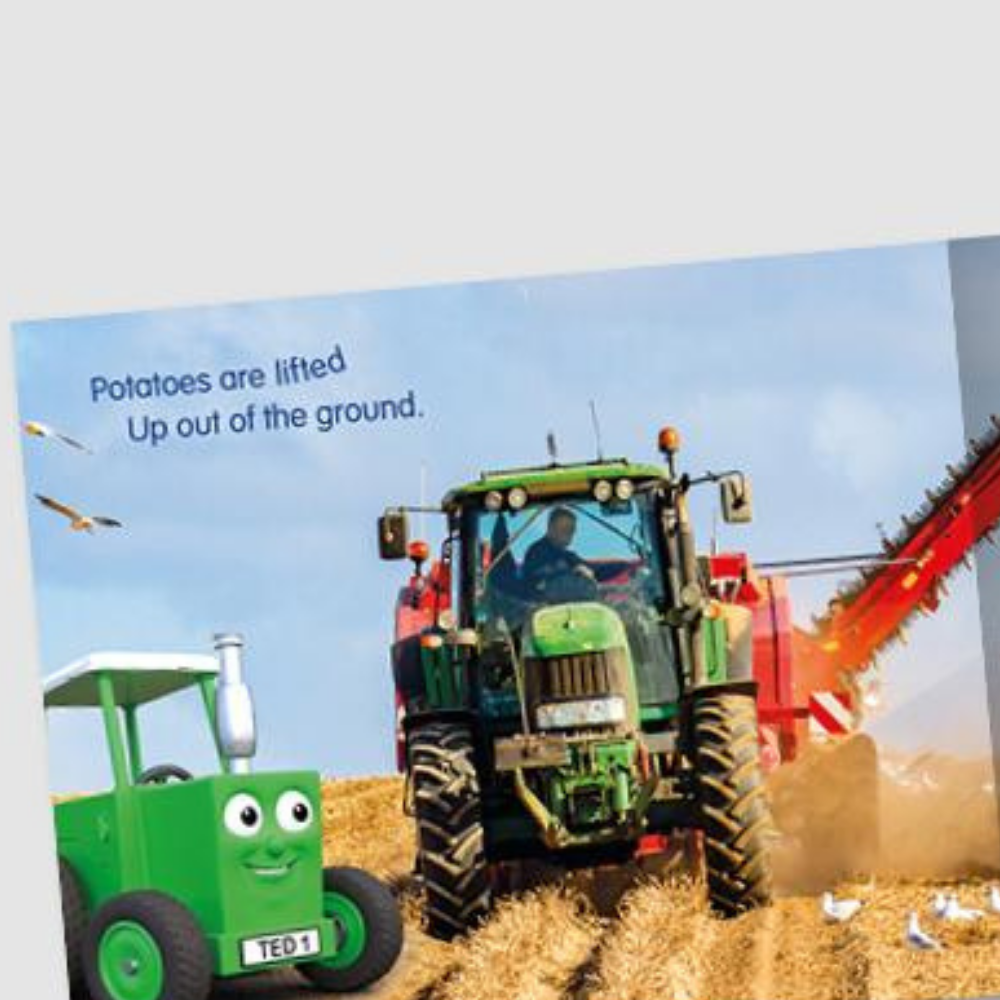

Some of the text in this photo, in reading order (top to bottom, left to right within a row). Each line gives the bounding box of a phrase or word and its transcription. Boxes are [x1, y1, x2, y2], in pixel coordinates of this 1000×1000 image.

[90, 344, 347, 402] Potatoes are lifted
[127, 390, 425, 446] Up out of the ground.
[257, 934, 312, 960] TED 1
